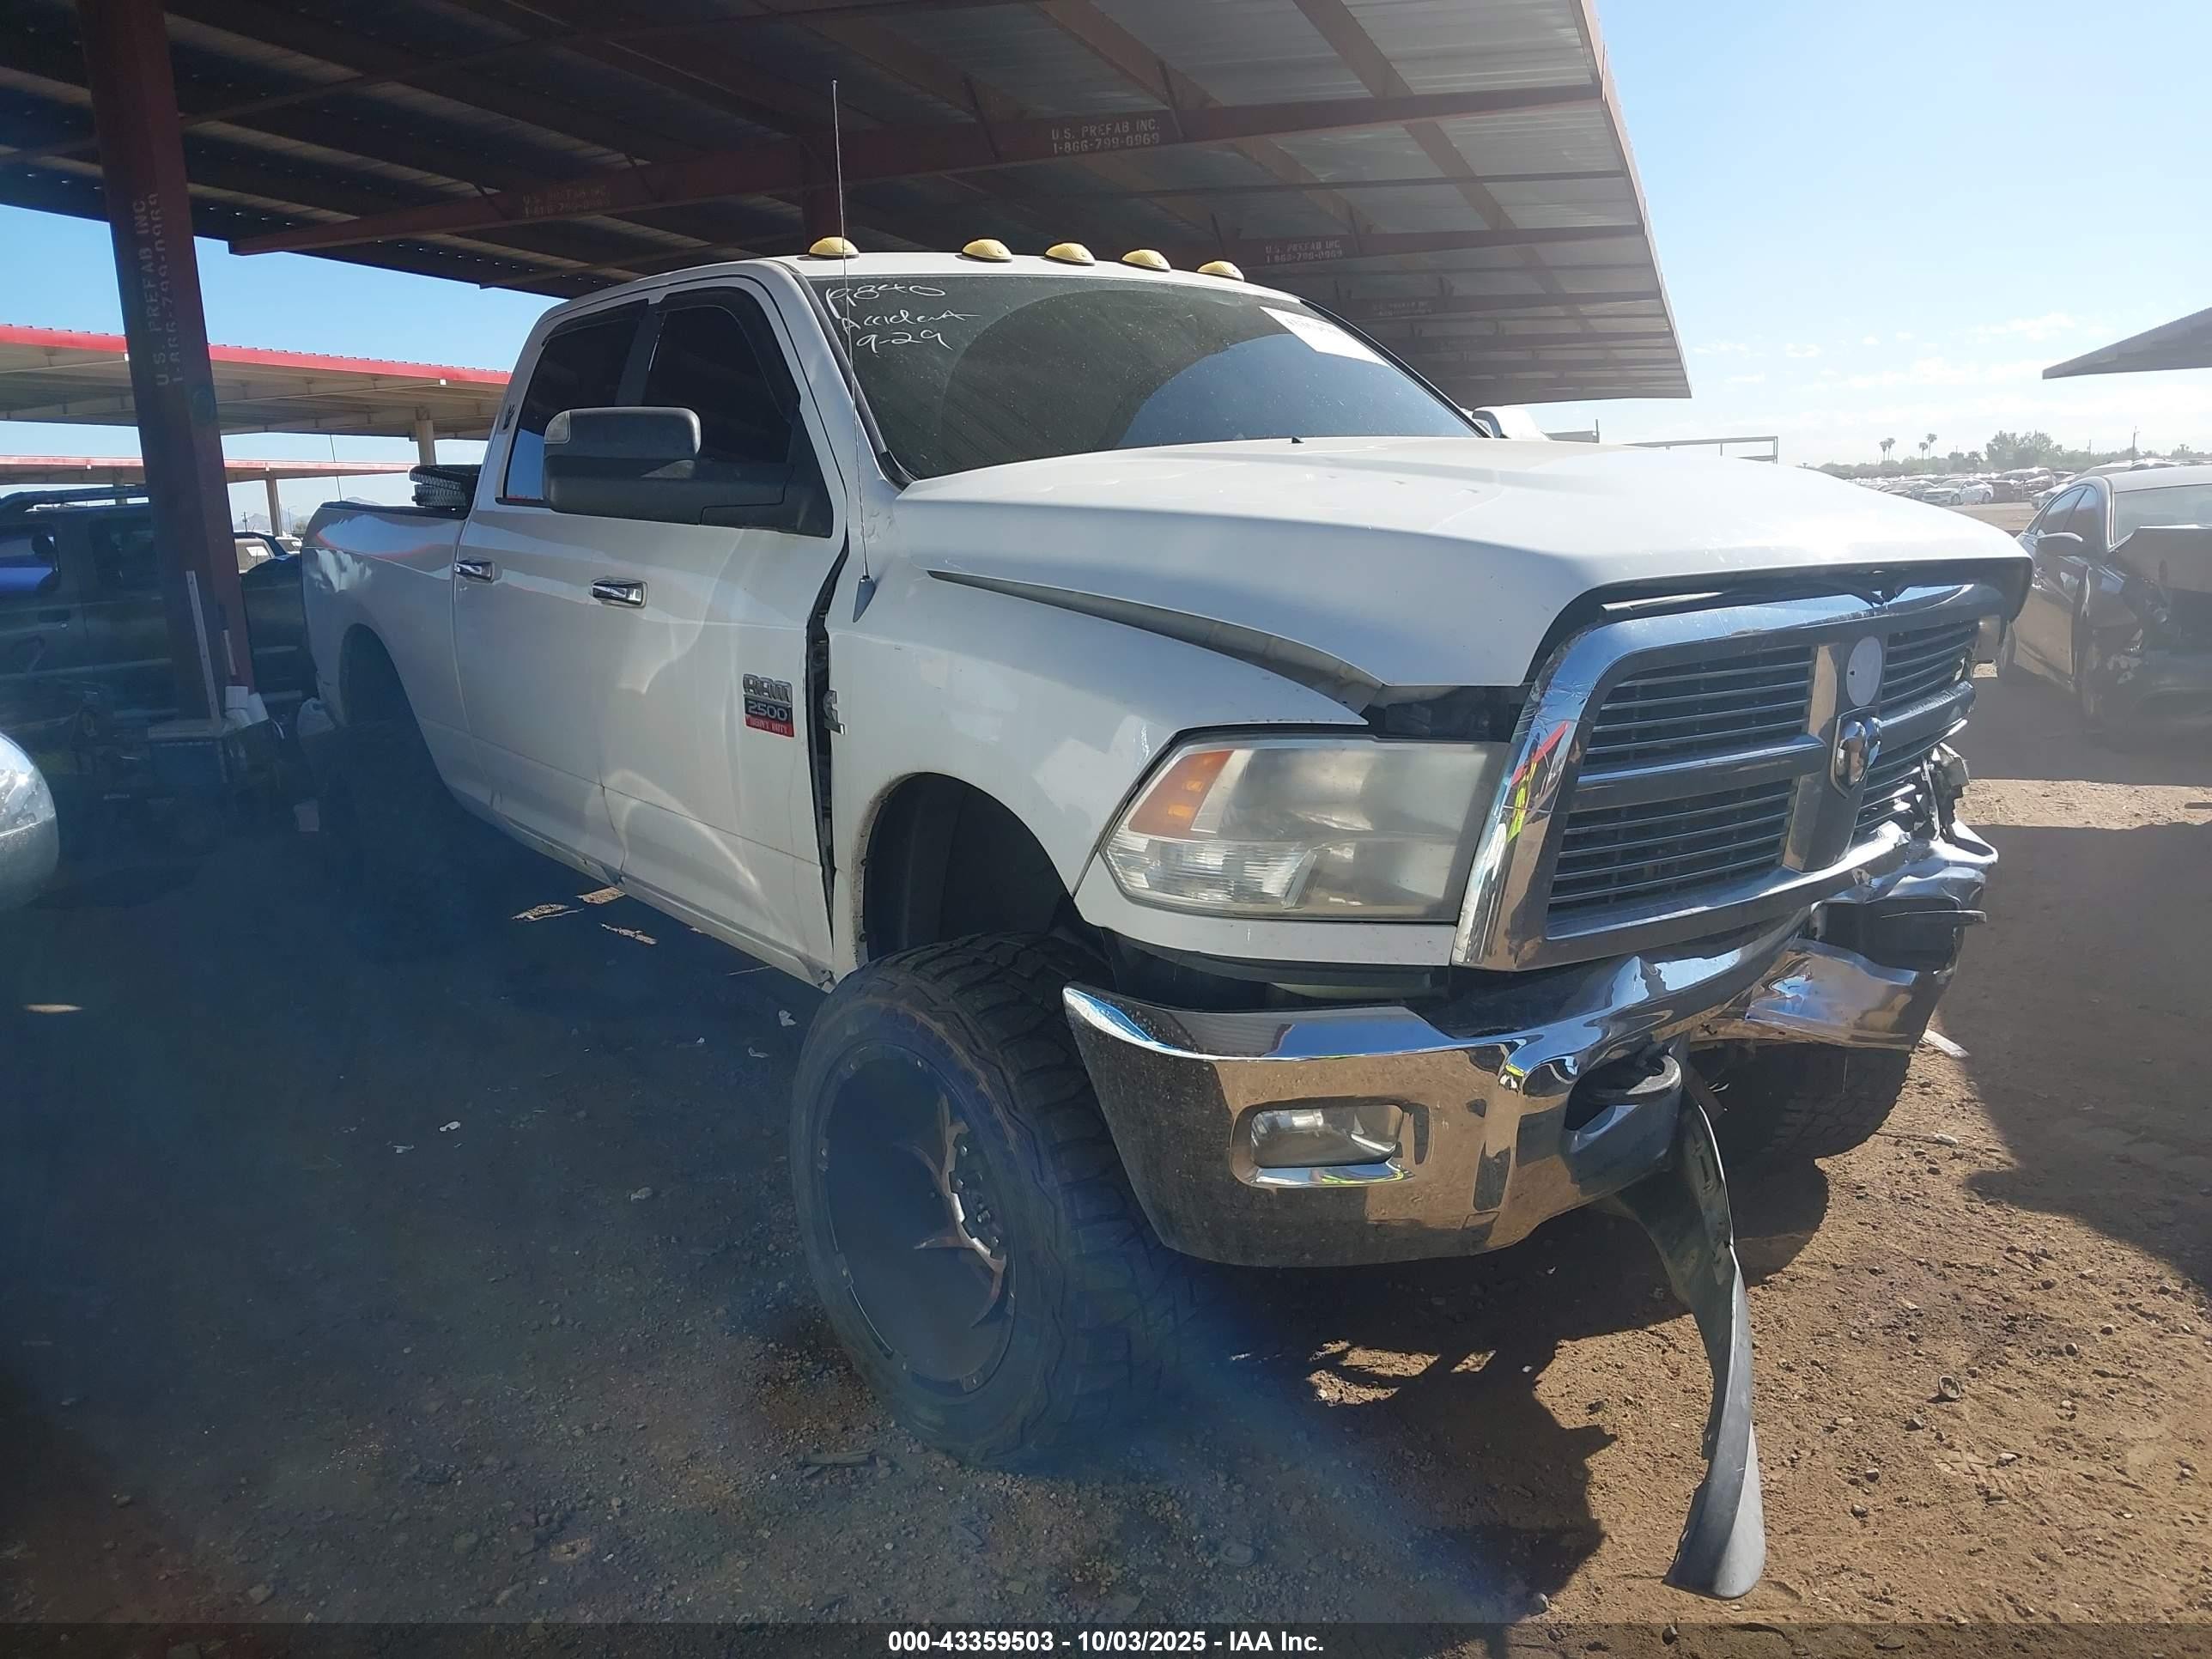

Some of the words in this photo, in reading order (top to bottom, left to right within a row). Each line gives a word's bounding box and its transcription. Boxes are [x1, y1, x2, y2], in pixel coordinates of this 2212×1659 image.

[1081, 121, 1130, 137] PREFAB
[1135, 118, 1160, 132] INC.
[1053, 132, 1160, 155] 1-866-799-0969
[138, 246, 162, 333] PREFAB
[856, 329, 953, 355] 9-29
[743, 673, 793, 703] RAM
[748, 700, 788, 721] 2500
